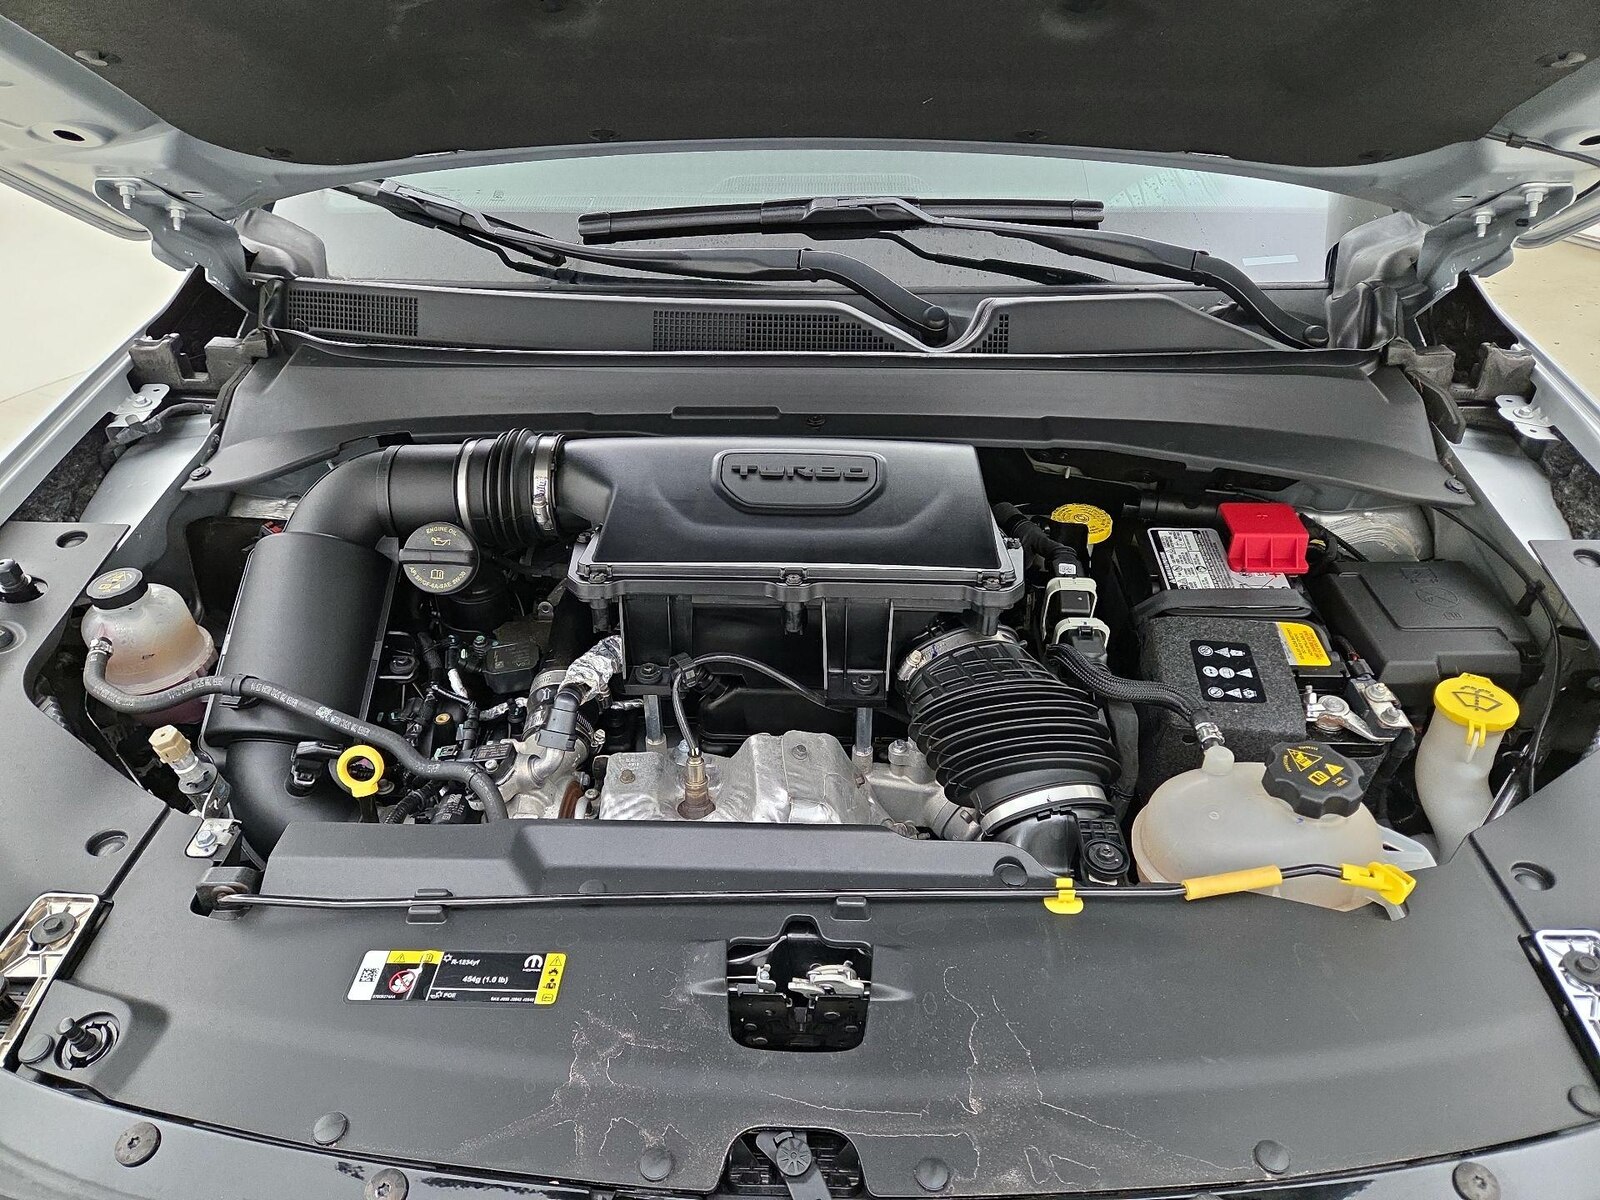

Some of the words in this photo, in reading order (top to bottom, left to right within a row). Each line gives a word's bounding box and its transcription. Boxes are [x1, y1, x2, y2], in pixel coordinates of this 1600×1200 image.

[731, 464, 869, 481] TURBO
[425, 526, 448, 534] ENGINE
[448, 528, 458, 536] OIL
[450, 958, 480, 967] R-1234yf
[462, 975, 481, 984] 454g
[482, 975, 498, 984] (1.0
[498, 976, 509, 984] lb)
